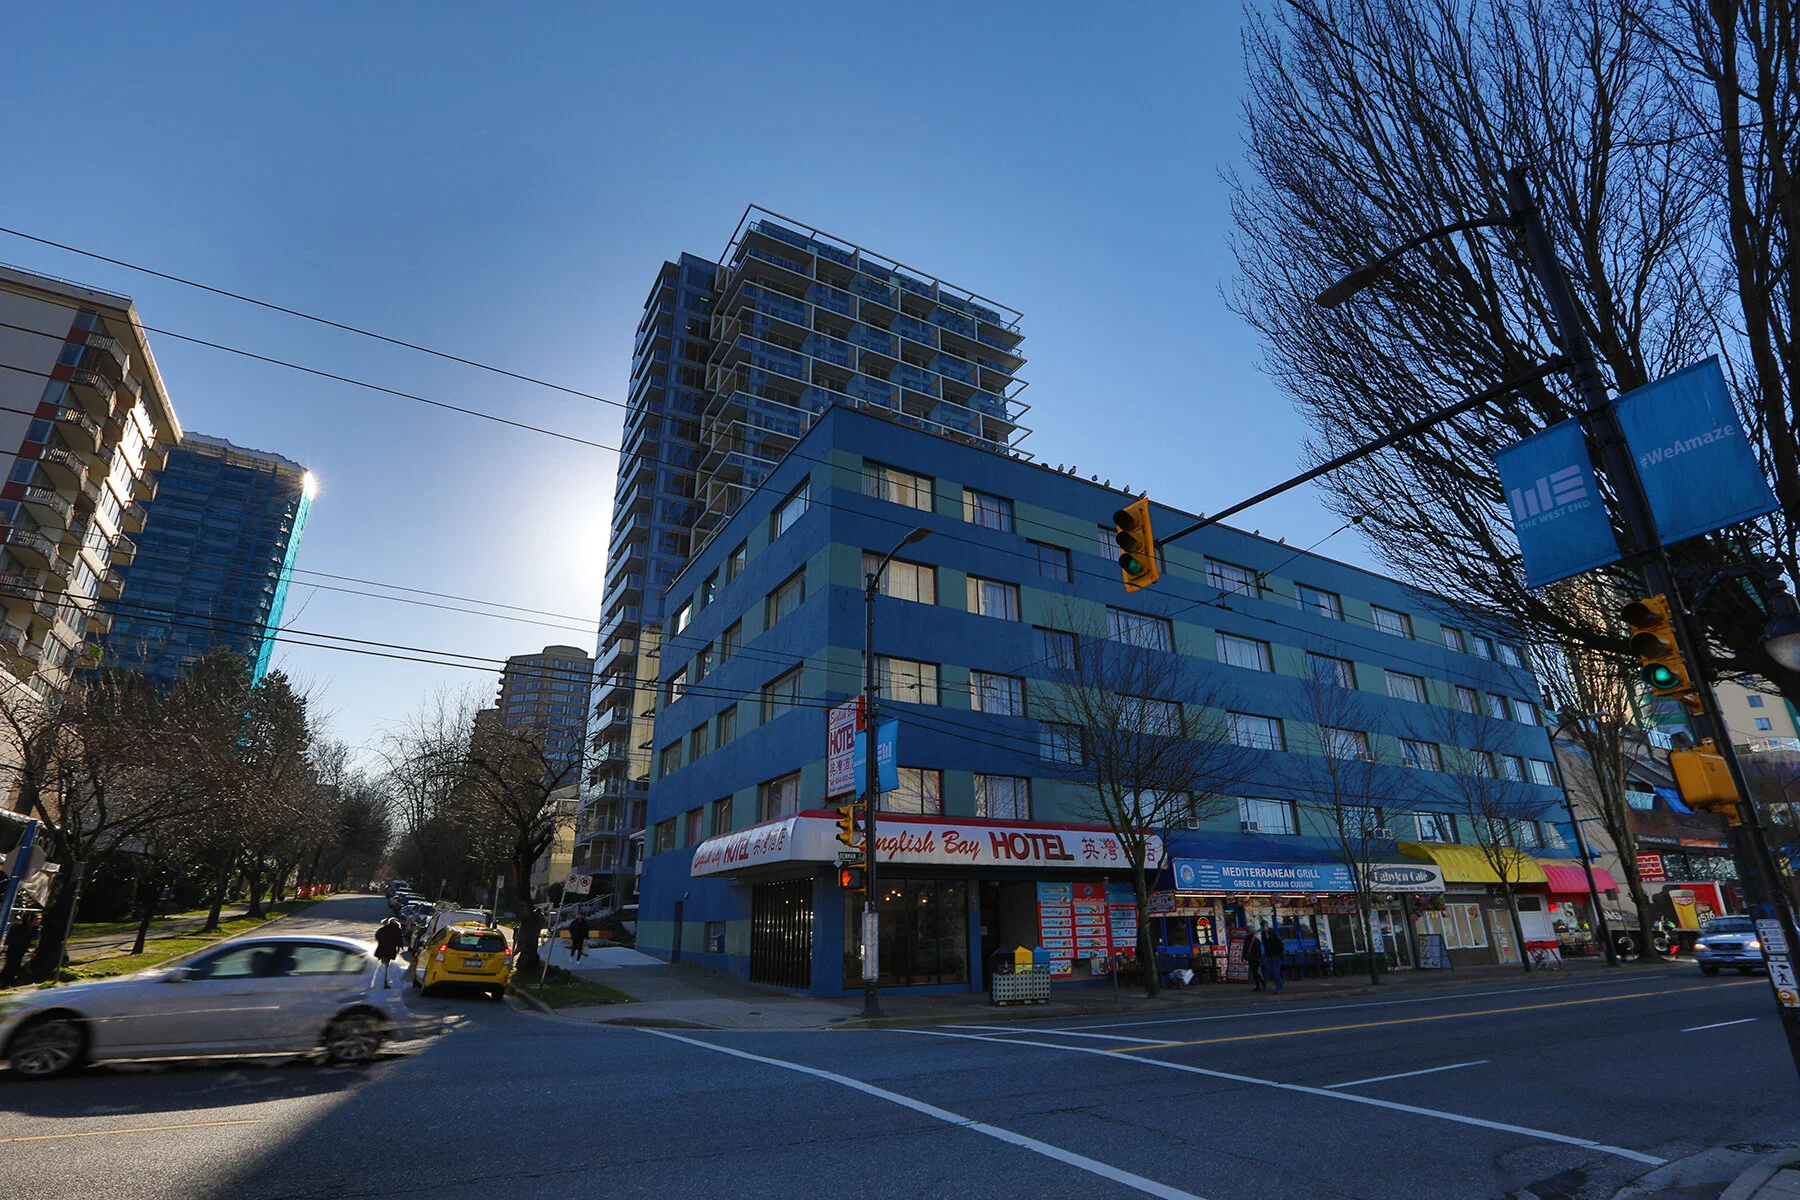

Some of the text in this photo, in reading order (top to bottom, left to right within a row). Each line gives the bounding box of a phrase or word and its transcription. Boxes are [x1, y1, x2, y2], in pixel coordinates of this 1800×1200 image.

[1639, 423, 1735, 469] #WeAmaze
[1519, 499, 1591, 531] THE WEST END
[830, 723, 855, 756] HOTEL
[724, 836, 750, 863] HOTEL
[941, 830, 981, 861] Bay
[988, 832, 1075, 861] HOTEL
[1222, 866, 1320, 879] MEDITERRANEAN GRILL
[1233, 880, 1314, 889] GREEK & PERSIAN CUISINE
[1409, 871, 1429, 882] Café
[1698, 910, 1716, 924] 1516
